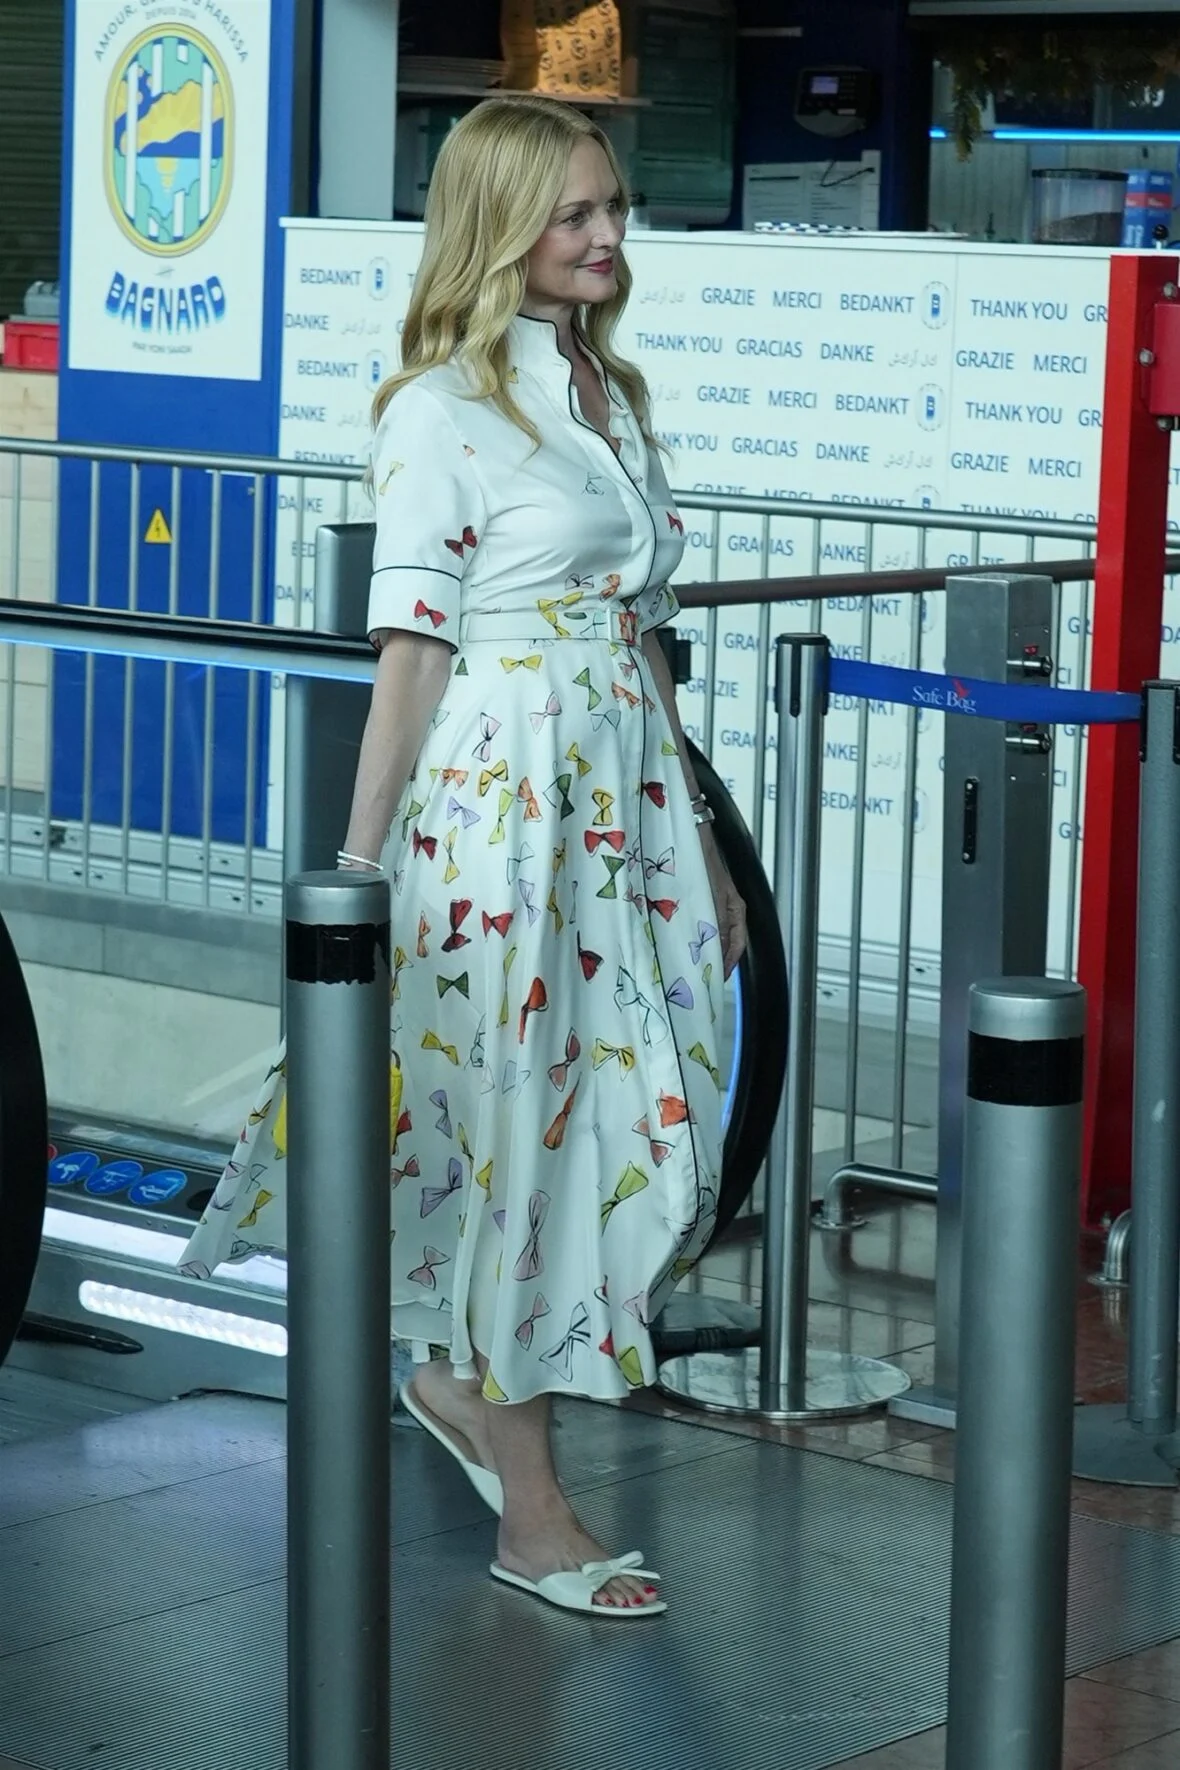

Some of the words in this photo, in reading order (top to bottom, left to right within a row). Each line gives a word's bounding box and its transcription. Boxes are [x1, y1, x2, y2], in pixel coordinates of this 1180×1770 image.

[300, 267, 361, 286] BEDANKT
[105, 269, 226, 334] BAGNARD
[701, 287, 755, 306] GRAZIE
[772, 290, 821, 309] MERCI
[839, 293, 915, 314] BEDANKT
[971, 299, 1027, 319] THANK
[1032, 302, 1068, 321] YOU
[284, 313, 329, 330] DANKE
[635, 332, 687, 351] THANK
[691, 336, 723, 353] YOU
[736, 338, 803, 358] GRACIAS
[820, 343, 875, 362] DANKE
[297, 359, 358, 378] BEDANKT
[956, 350, 1014, 370] GRAZIE
[1033, 354, 1087, 374] MERCI
[697, 385, 751, 404] GRAZIE
[768, 390, 817, 409] MERCI
[835, 394, 910, 416] BEDANKT
[282, 404, 326, 422] DANKE
[965, 401, 1022, 421] THANK
[1026, 405, 1062, 424] YOU
[687, 434, 718, 452] YOU
[732, 437, 798, 457] GRACIAS
[816, 443, 870, 463] DANKE
[951, 452, 1009, 473] GRAZIE
[1028, 457, 1082, 478] MERCI
[279, 494, 323, 513] DAKE
[728, 534, 794, 556] GRAIAS
[821, 543, 866, 563] ANKE
[686, 678, 739, 698] GRZIE
[912, 685, 944, 705] Safe
